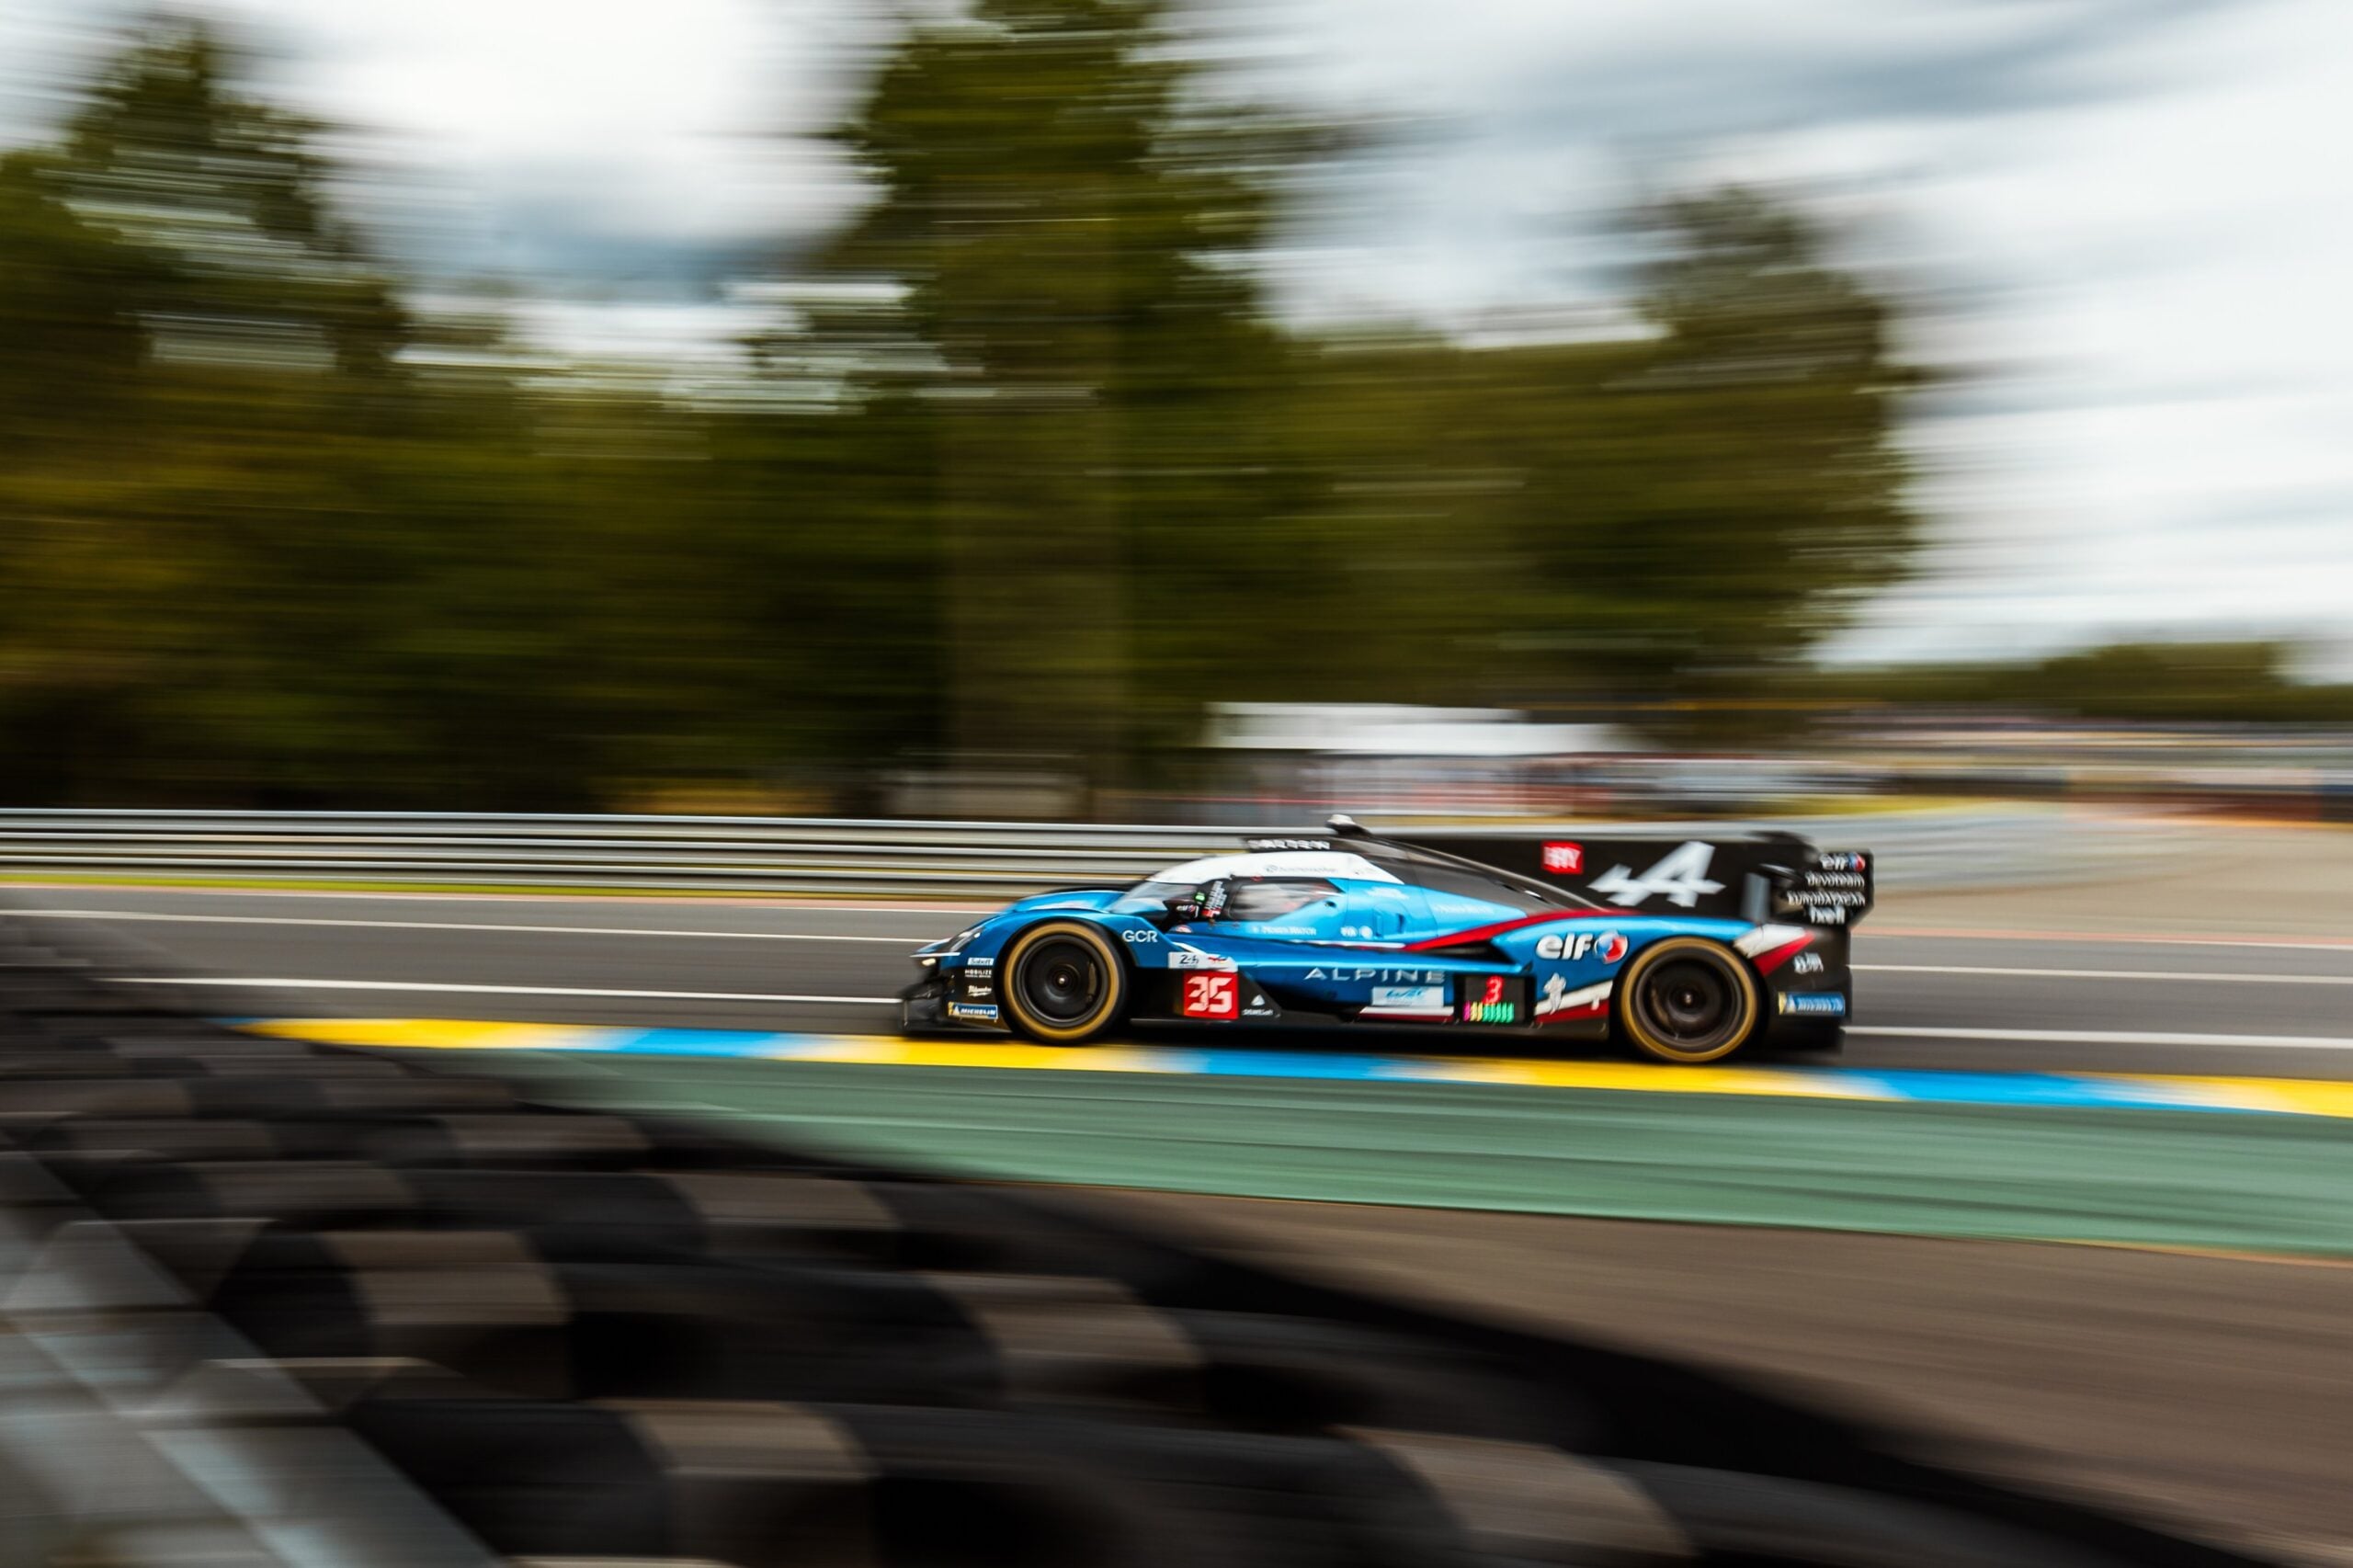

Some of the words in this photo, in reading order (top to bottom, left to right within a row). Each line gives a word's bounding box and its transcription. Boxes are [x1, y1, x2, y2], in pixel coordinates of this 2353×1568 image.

[1121, 930, 1158, 943] GCR
[1536, 932, 1594, 960] elf
[1303, 967, 1446, 983] ALPINE
[1187, 976, 1233, 1013] 35
[1483, 975, 1505, 1004] 3
[961, 1007, 996, 1016] MICHELIN
